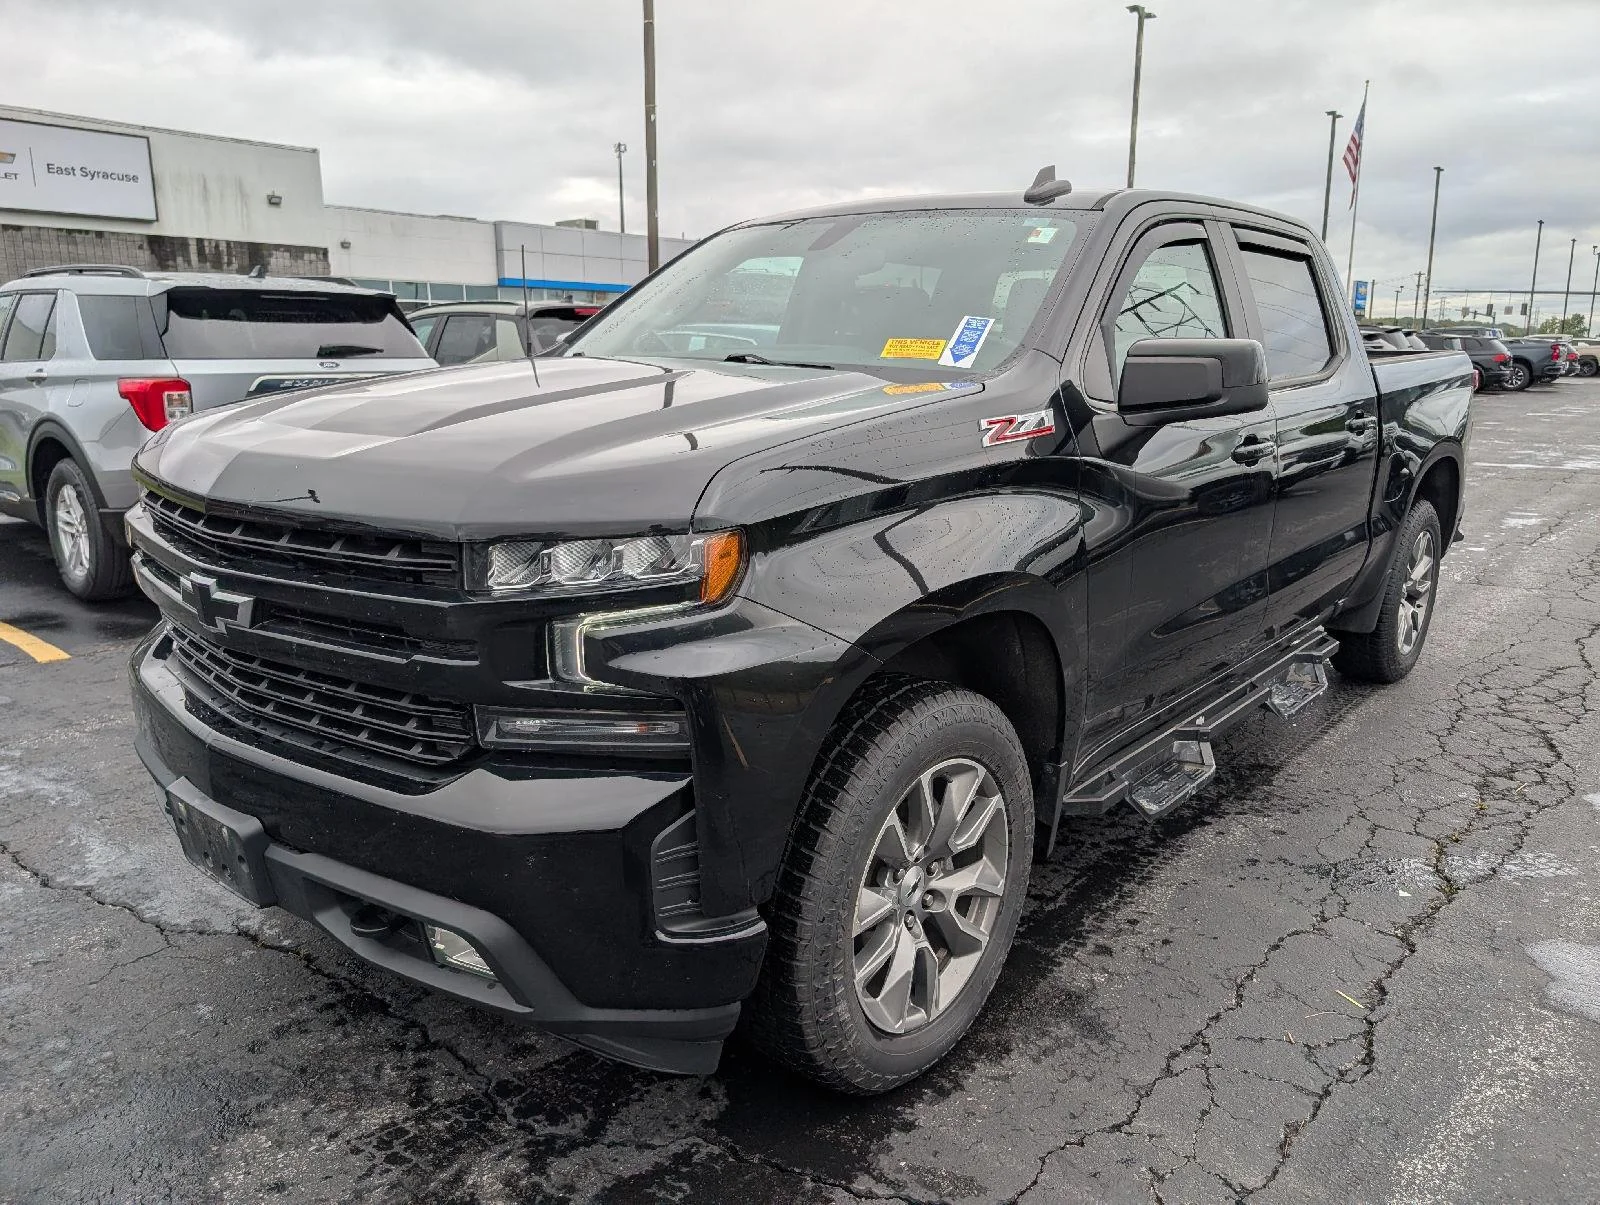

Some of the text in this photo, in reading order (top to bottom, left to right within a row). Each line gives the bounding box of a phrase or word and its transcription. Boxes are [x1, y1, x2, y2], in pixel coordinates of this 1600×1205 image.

[46, 163, 139, 183] East Syracuse
[980, 408, 1056, 448] Z71
